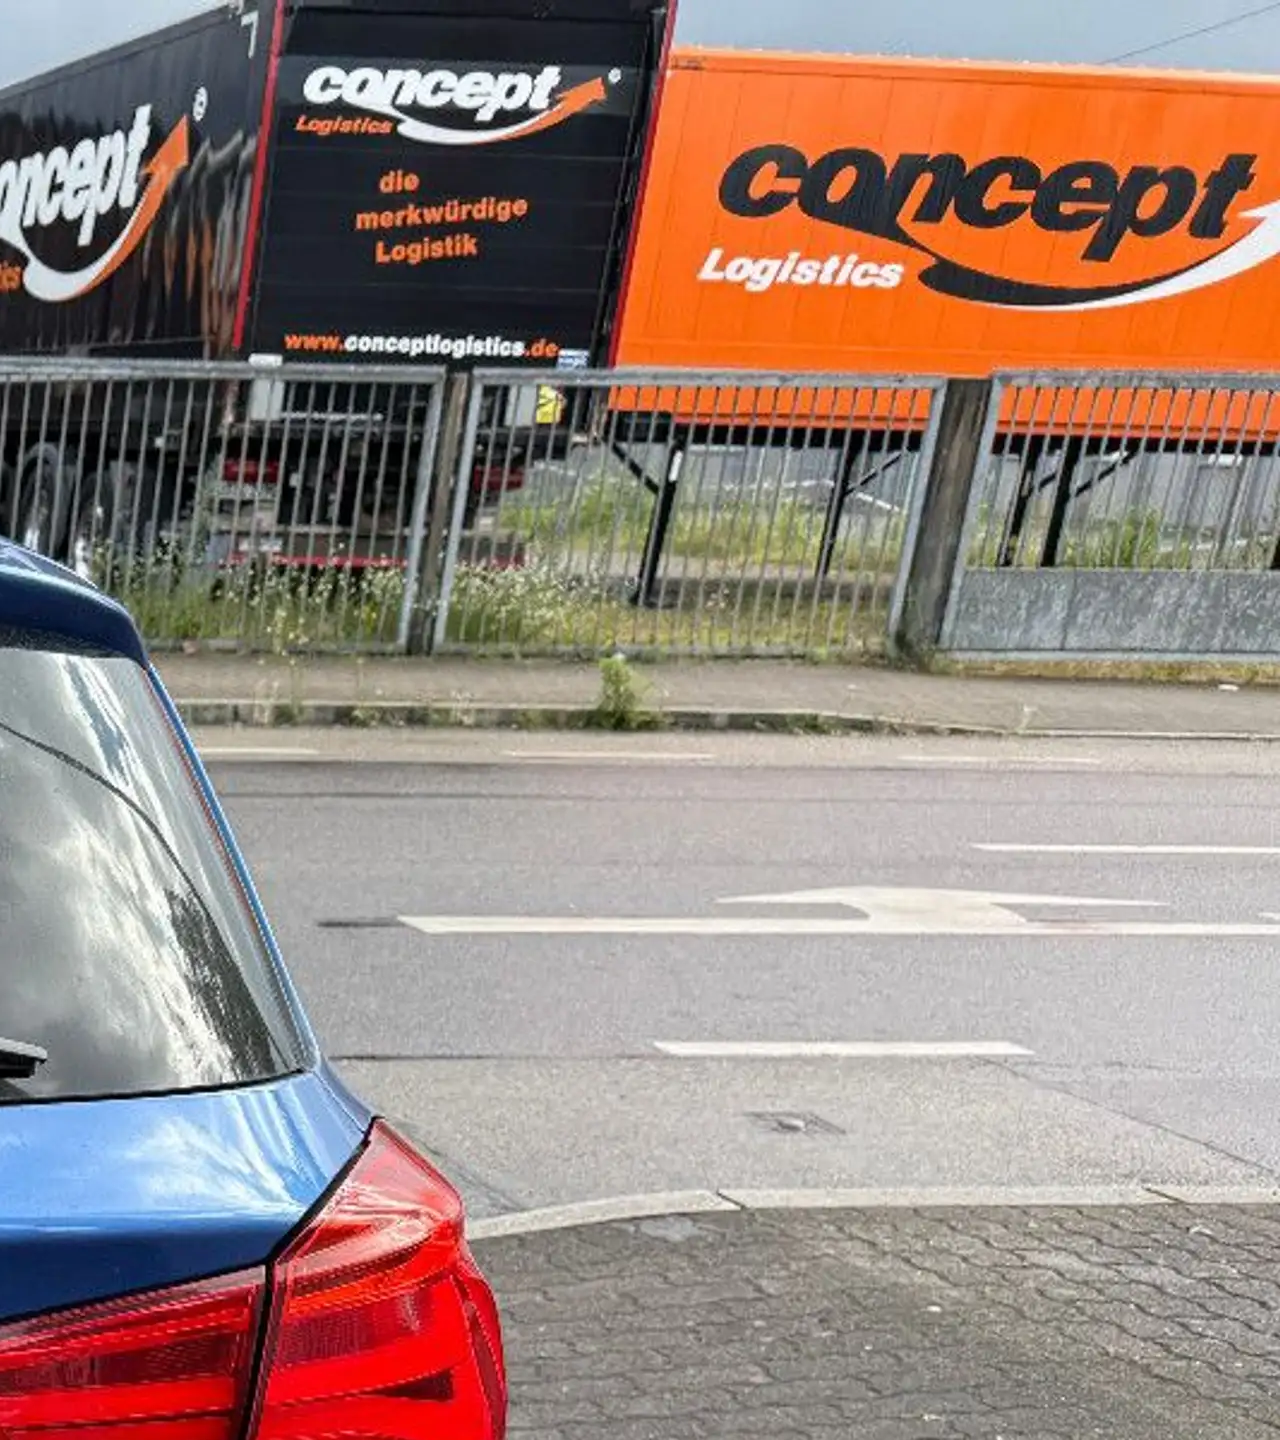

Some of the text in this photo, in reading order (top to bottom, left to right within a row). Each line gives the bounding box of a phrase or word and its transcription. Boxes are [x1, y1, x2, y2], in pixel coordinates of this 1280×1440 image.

[303, 66, 561, 121] concept
[296, 115, 394, 136] Logistics
[379, 169, 420, 194] die
[355, 196, 529, 231] merkwürdige
[718, 144, 1257, 262] concept
[374, 233, 479, 266] Logistik
[697, 247, 906, 292] Logistics
[283, 331, 560, 358] www.conceptlogistics.de
